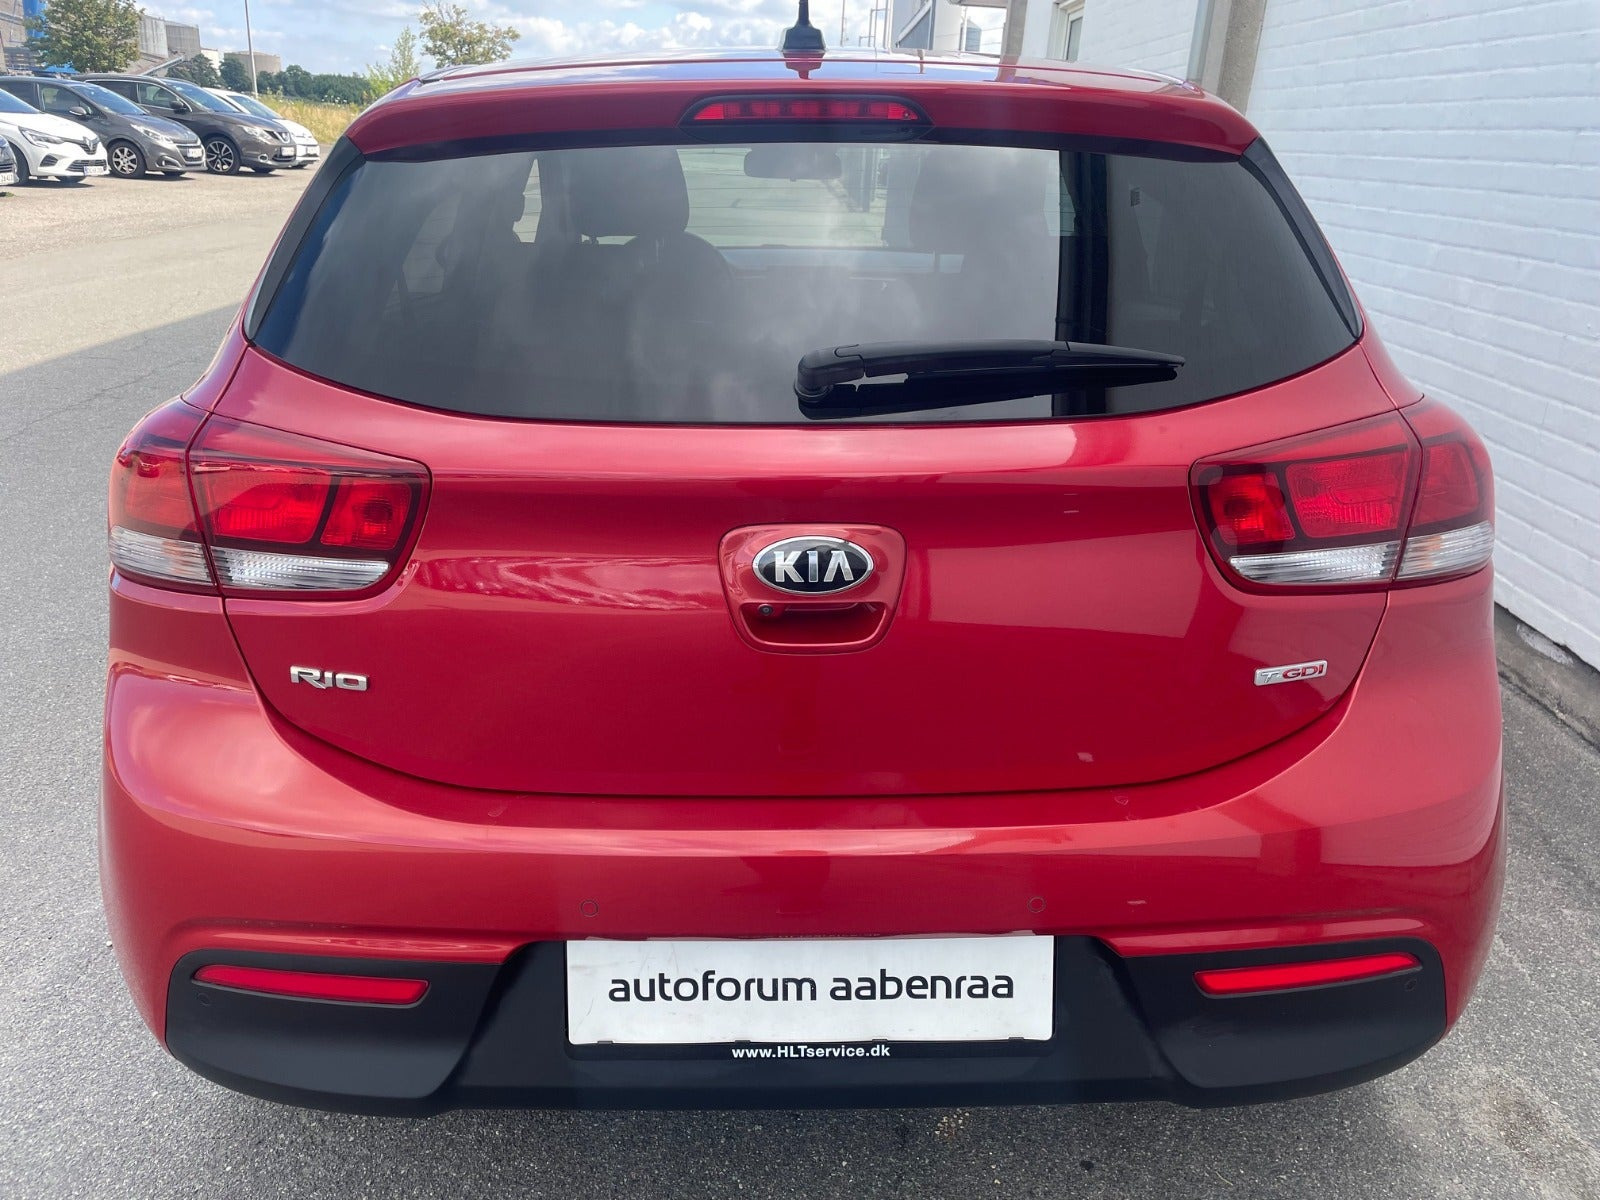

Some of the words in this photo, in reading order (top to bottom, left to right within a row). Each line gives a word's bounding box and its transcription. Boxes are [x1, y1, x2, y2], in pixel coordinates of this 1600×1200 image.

[773, 550, 855, 583] KIA
[290, 665, 368, 691] RIO
[608, 969, 817, 1002] autoforum
[829, 968, 1014, 1001] aabenraa
[731, 1044, 891, 1059] www.HLTservice.dk
